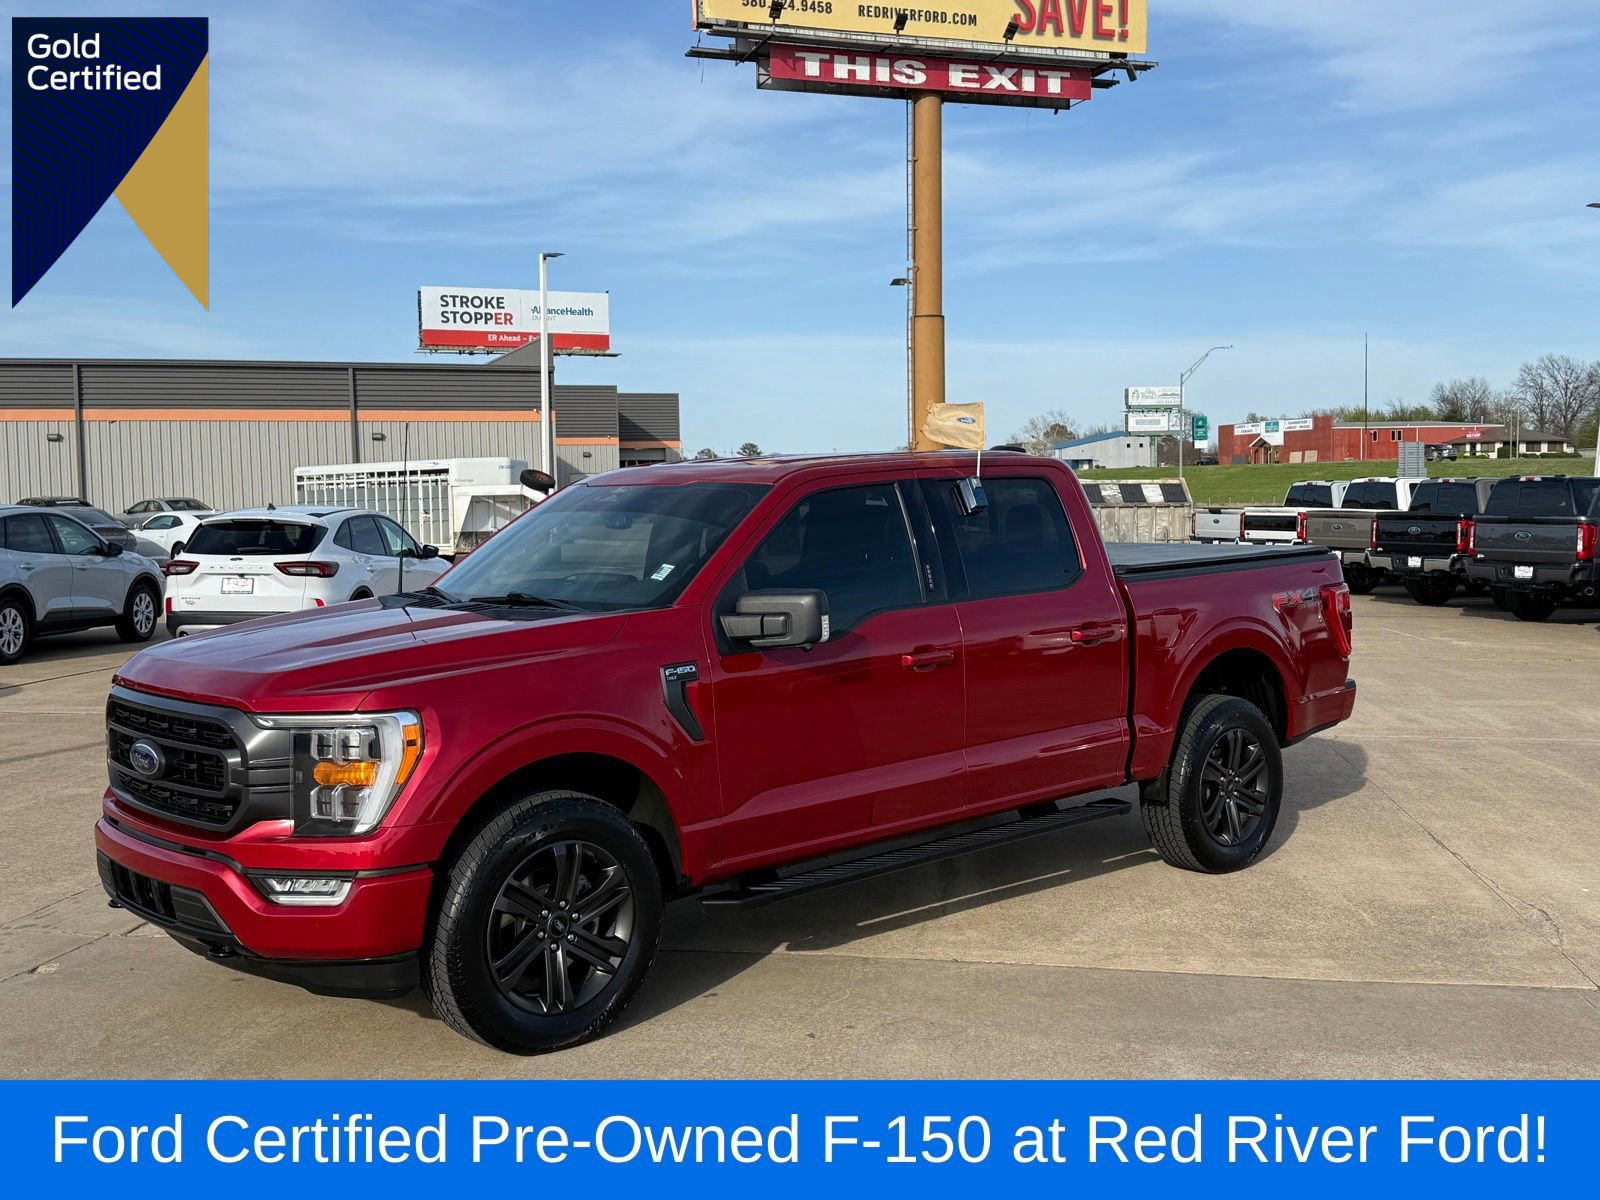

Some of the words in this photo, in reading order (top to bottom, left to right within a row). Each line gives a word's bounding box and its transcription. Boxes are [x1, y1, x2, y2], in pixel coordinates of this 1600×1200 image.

[742, 0, 832, 14] 580.24.9458
[794, 51, 927, 85] THIS
[948, 63, 1070, 94] EXIT
[440, 294, 505, 309] STROKE
[440, 310, 514, 325] STOPPER
[531, 305, 594, 316] AlanceHealth
[665, 665, 697, 676] F-150
